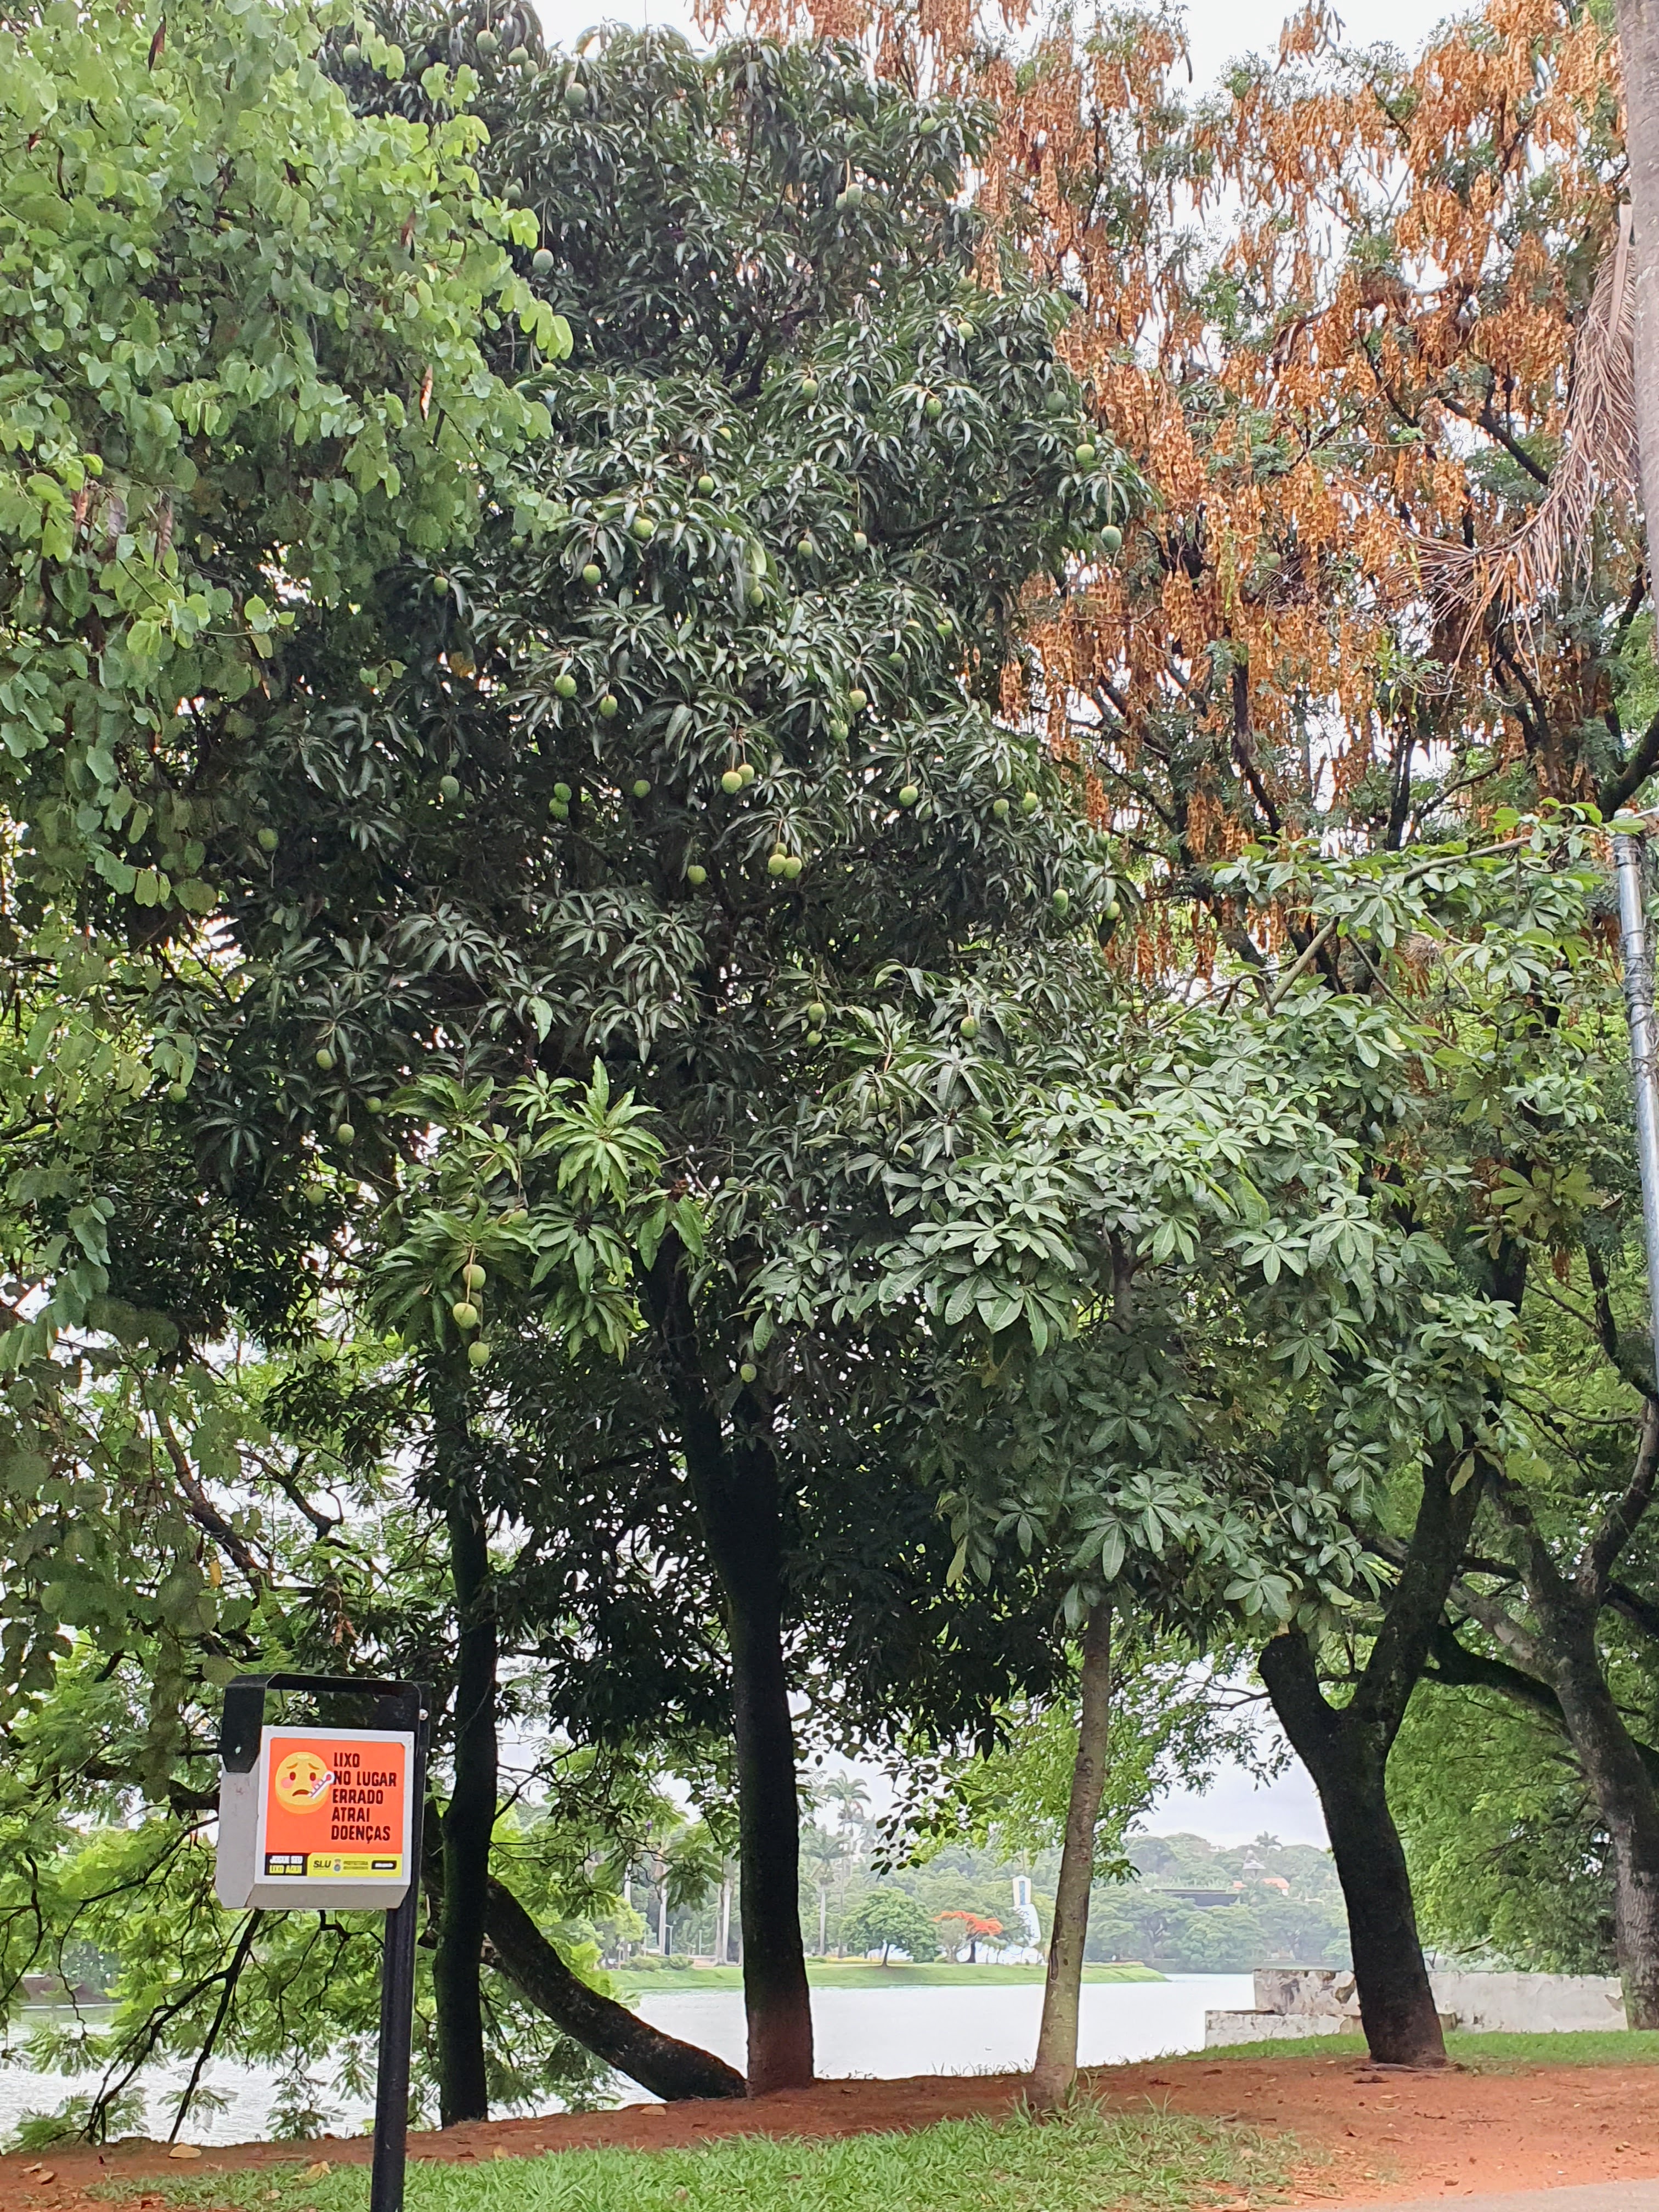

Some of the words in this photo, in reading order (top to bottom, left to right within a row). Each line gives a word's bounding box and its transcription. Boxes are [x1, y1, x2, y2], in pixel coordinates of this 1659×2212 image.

[334, 1752, 360, 1768] LIXO
[333, 1770, 351, 1785] NO
[357, 1771, 397, 1787] LUGAR
[332, 1788, 383, 1804] ERRADO
[331, 1807, 370, 1822] ATRAI
[331, 1825, 391, 1844] DOENÇAS
